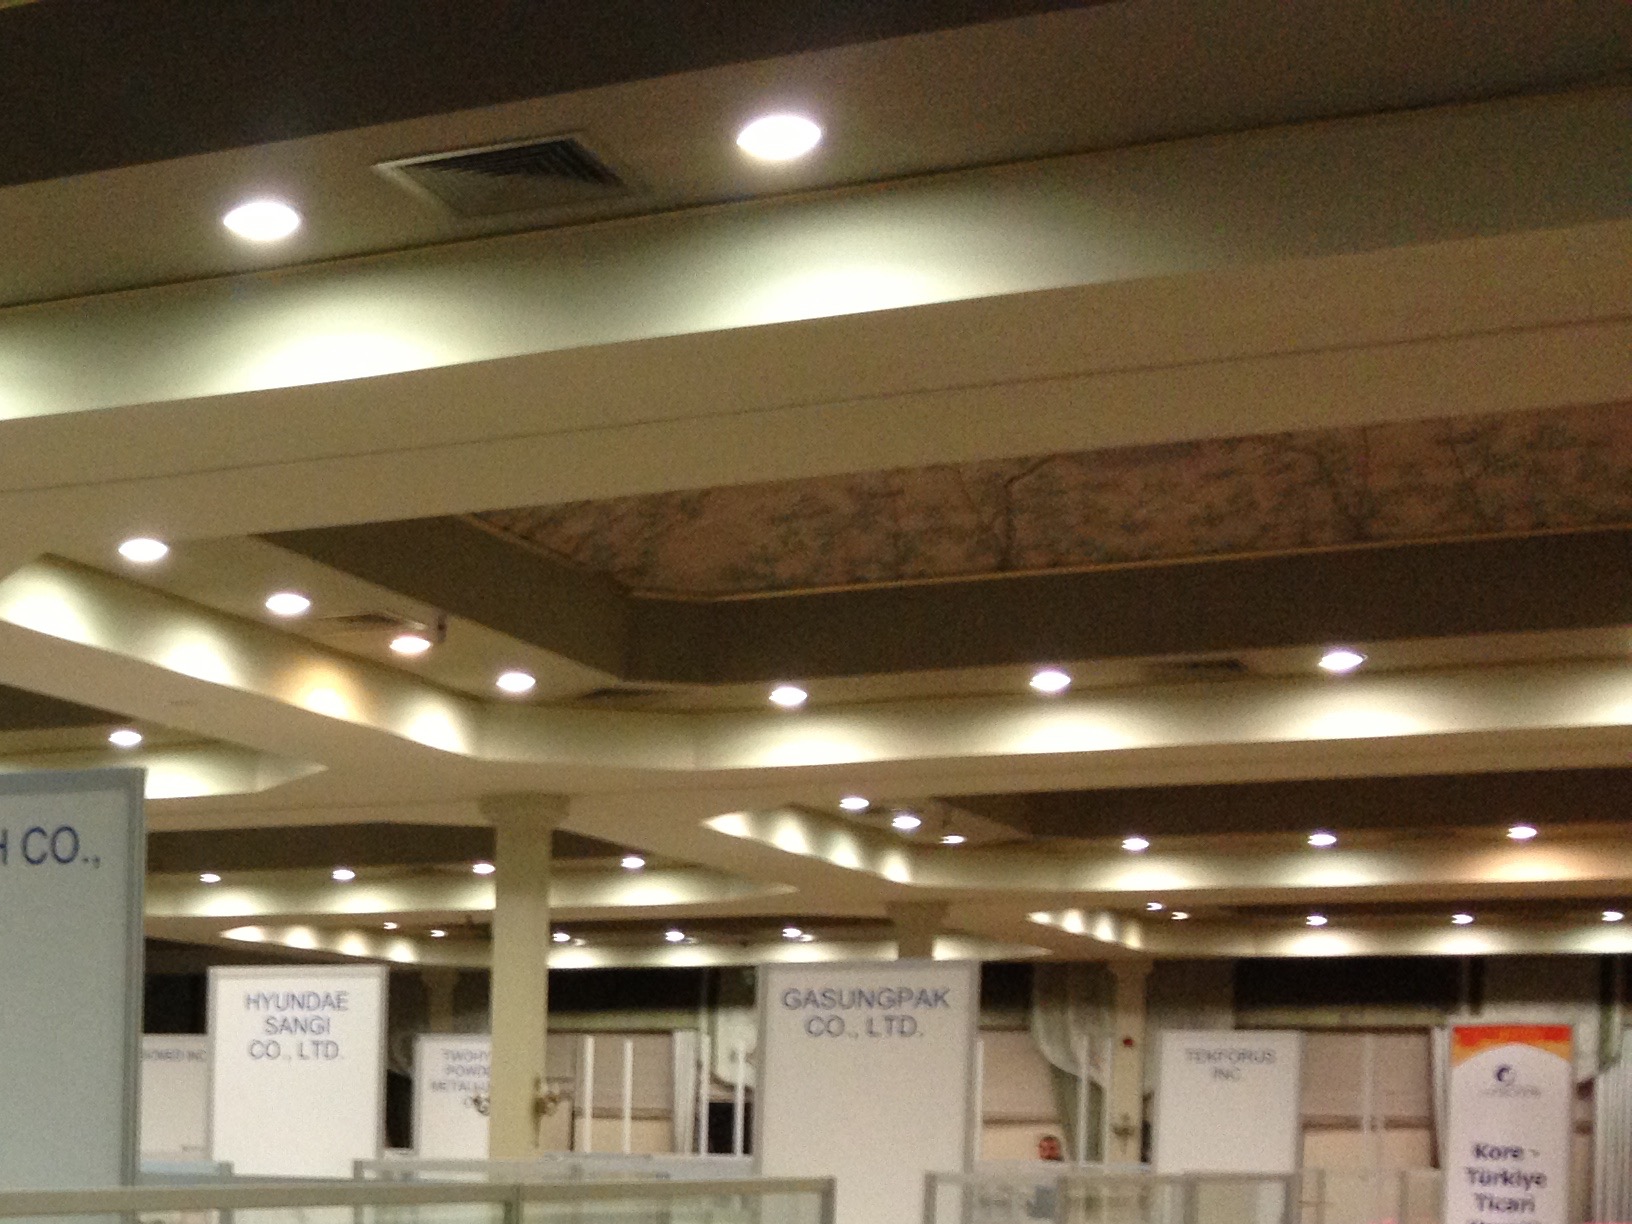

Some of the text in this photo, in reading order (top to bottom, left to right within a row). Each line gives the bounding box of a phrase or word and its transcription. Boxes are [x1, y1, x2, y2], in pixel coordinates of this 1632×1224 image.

[21, 826, 102, 870] CO.,
[244, 990, 350, 1012] HYUNDAE
[780, 986, 952, 1013] GASUNGPAK
[264, 1015, 331, 1036] SANGI
[803, 1014, 925, 1041] CO., LTD.
[1473, 1143, 1525, 1161] Kore
[1466, 1166, 1548, 1191] Türkiye
[1473, 1192, 1536, 1214] Ticari
